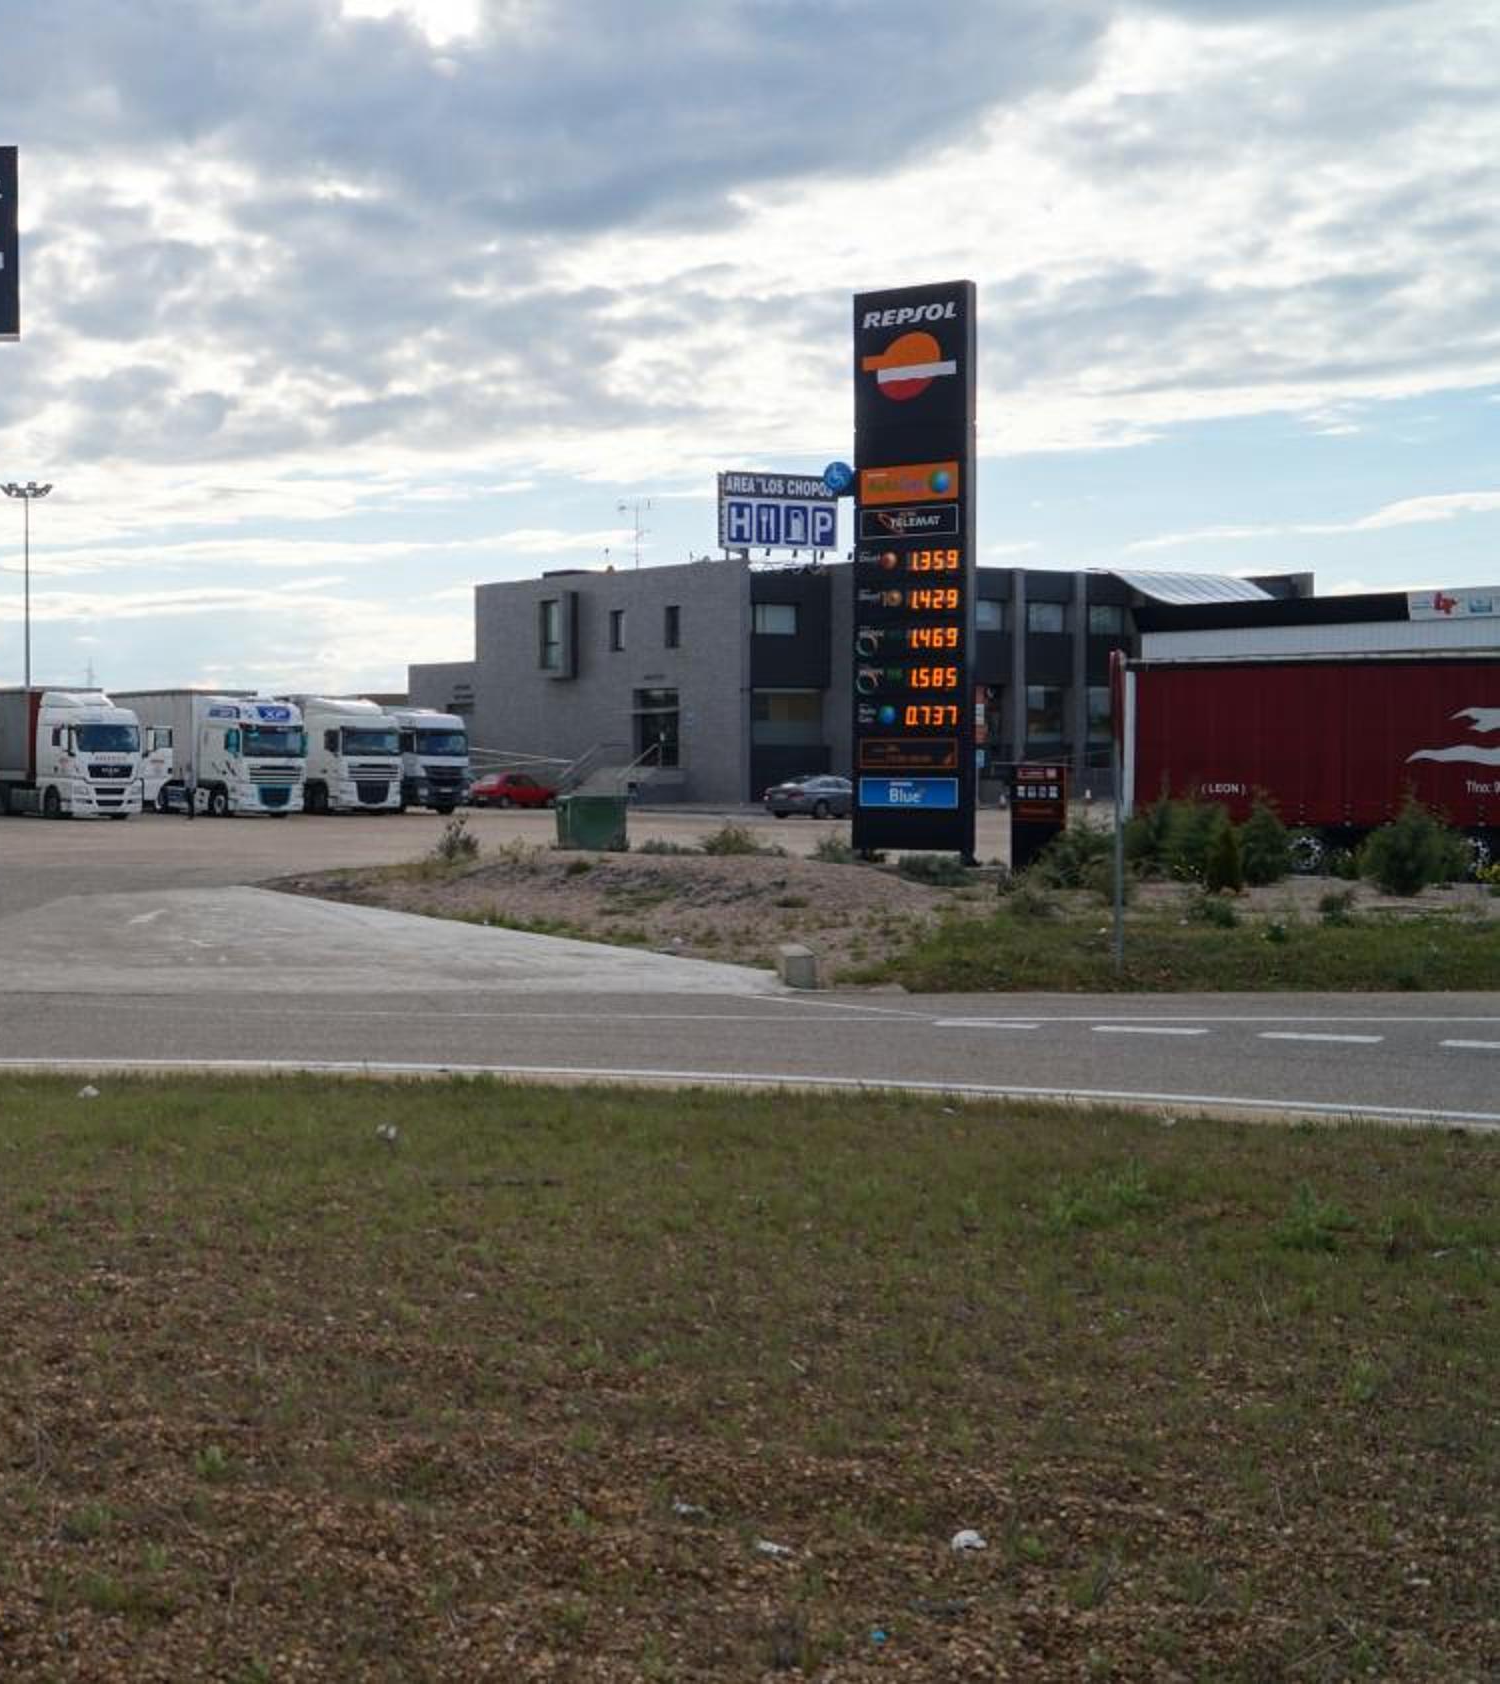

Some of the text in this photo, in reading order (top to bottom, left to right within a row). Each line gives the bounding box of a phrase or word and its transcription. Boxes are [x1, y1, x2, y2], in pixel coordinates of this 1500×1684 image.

[862, 301, 957, 329] REPSOL
[725, 475, 756, 493] AREA
[730, 506, 833, 543] H P
[890, 515, 941, 529] TELEMAT
